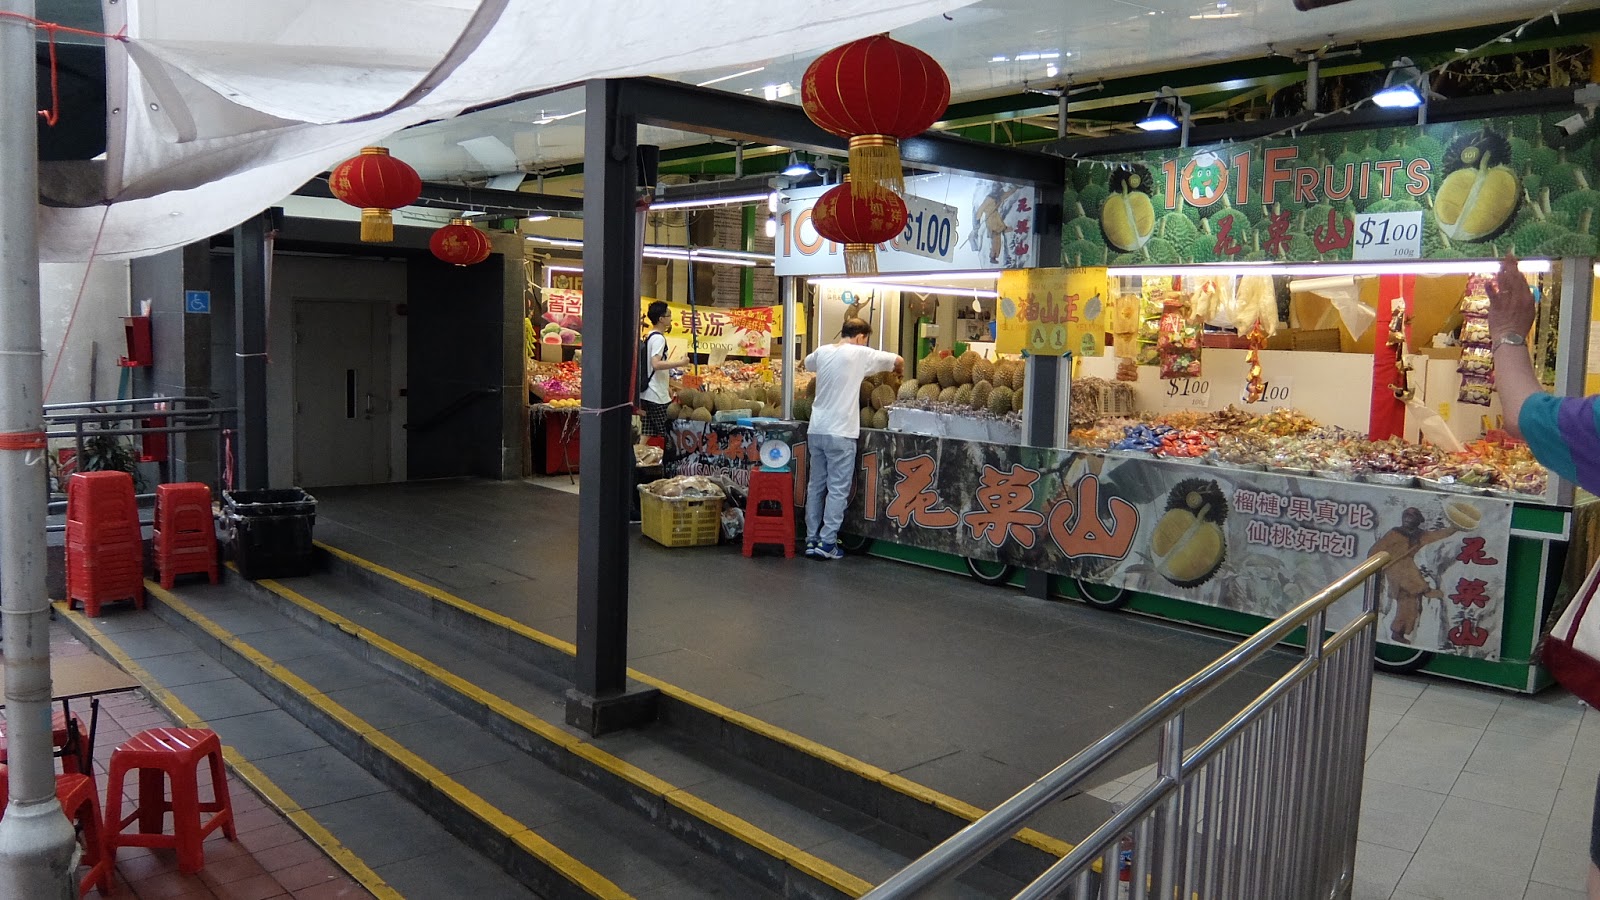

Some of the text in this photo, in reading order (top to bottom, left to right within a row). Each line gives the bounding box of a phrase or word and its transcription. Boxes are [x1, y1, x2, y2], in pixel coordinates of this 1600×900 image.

[1162, 146, 1432, 210] 101 FRUITS
[903, 210, 951, 257] $1.00
[1355, 216, 1418, 249] $1.00
[1393, 248, 1415, 258] 100g
